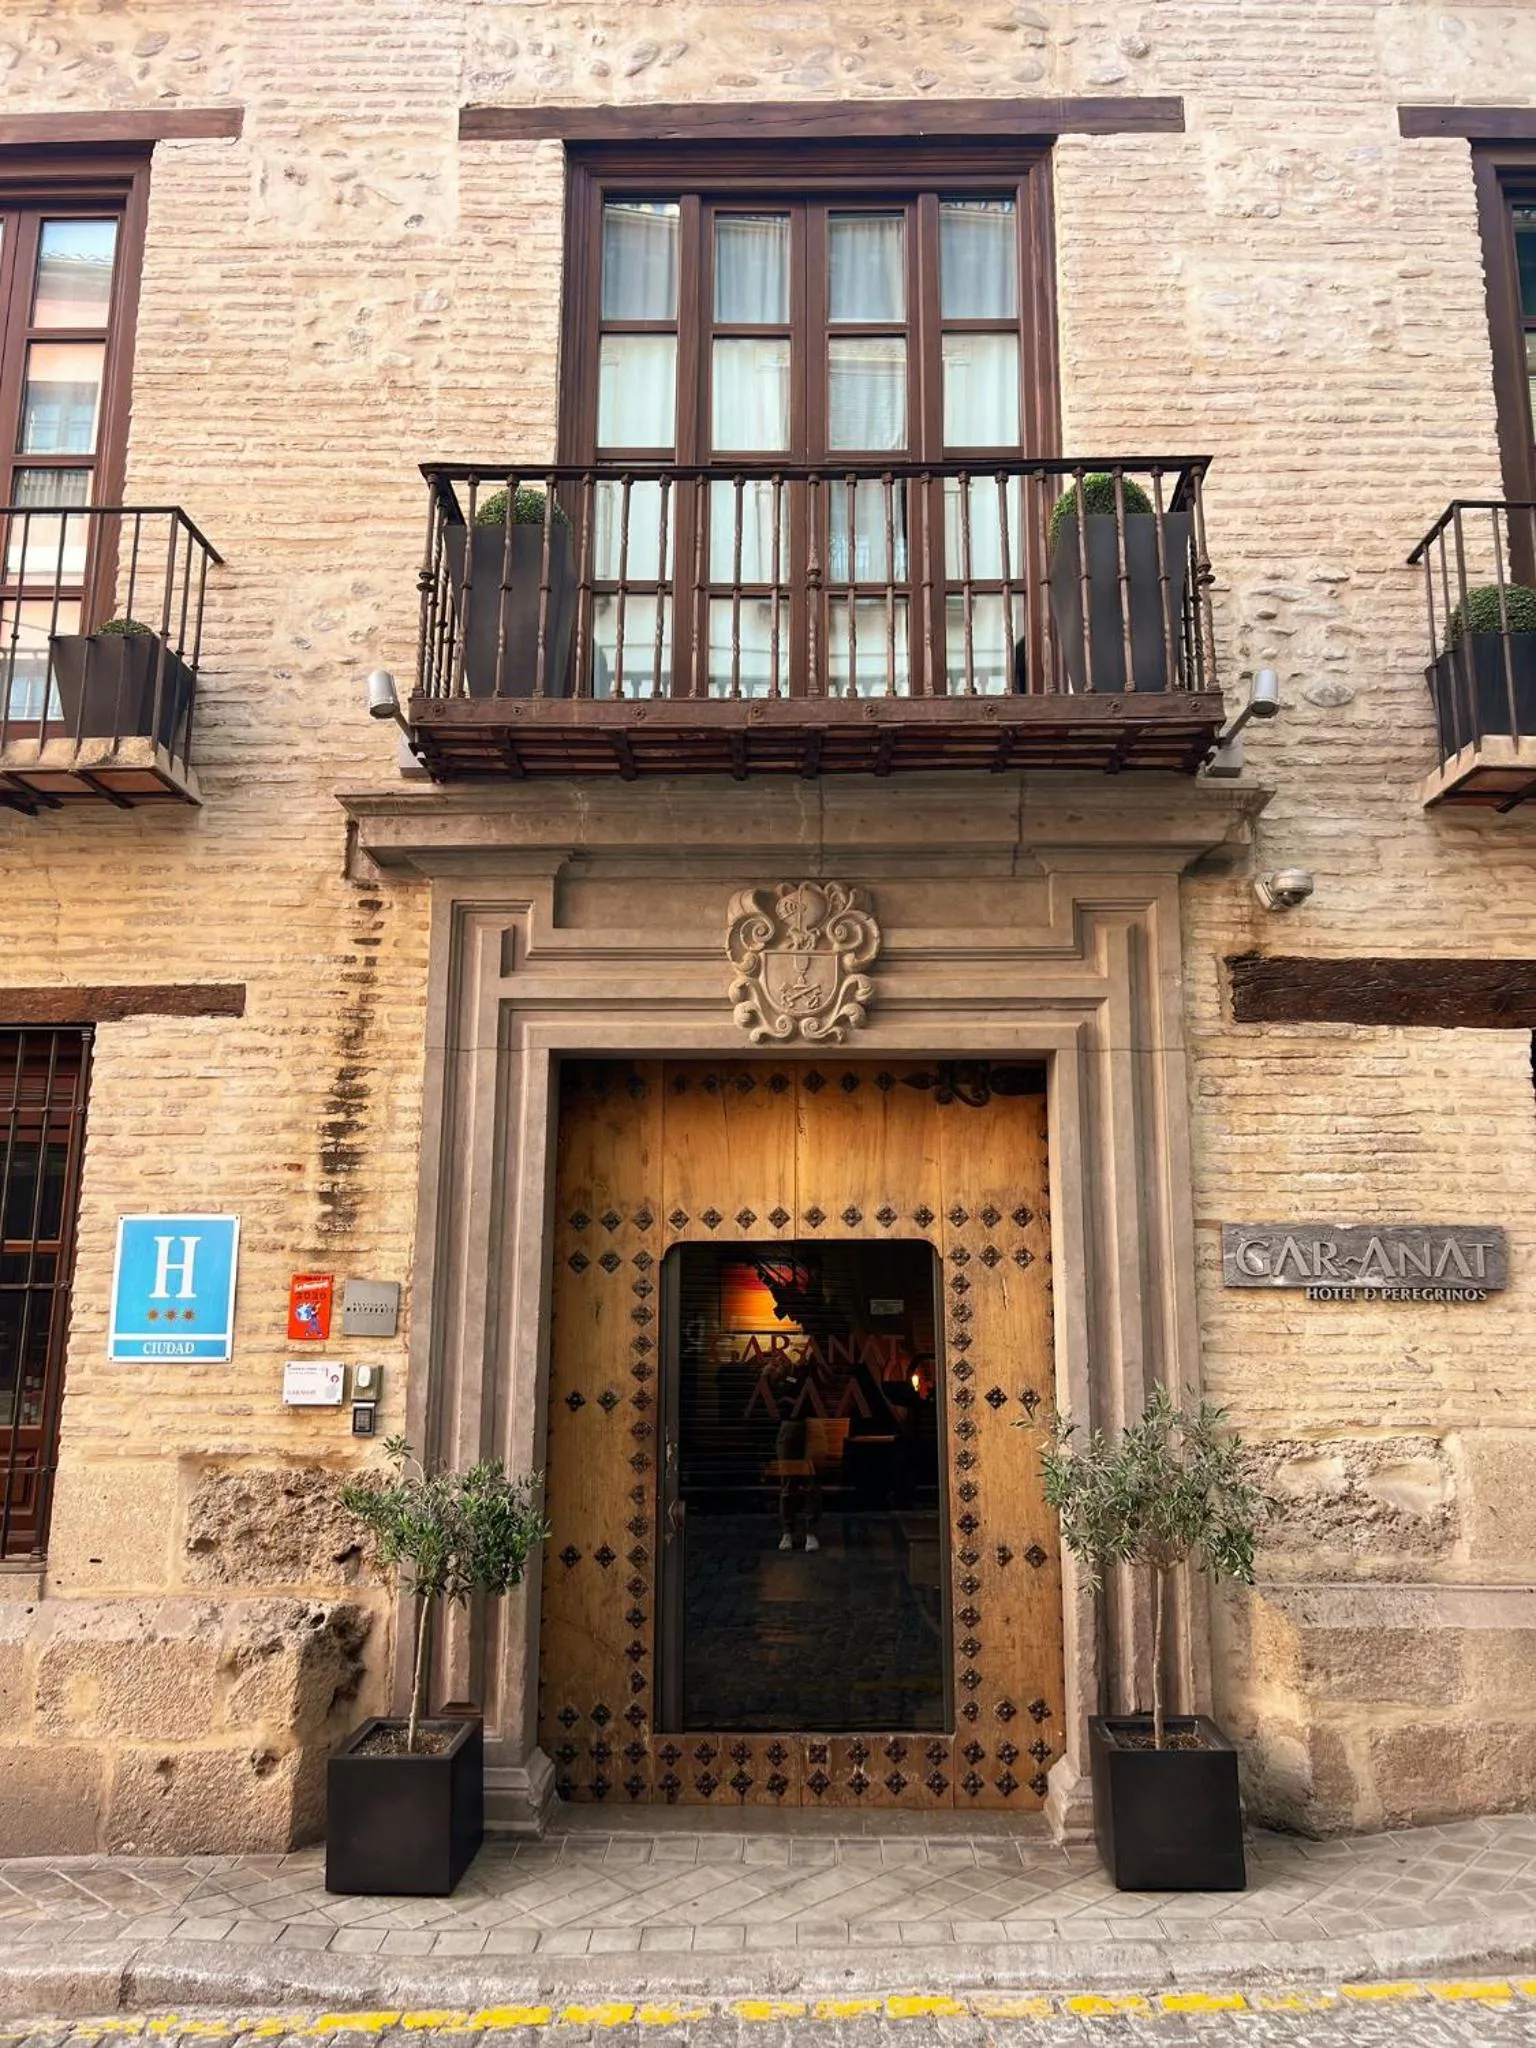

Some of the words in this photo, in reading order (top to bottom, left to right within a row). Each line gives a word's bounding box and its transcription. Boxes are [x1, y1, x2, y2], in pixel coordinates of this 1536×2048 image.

[148, 1235, 202, 1299] H
[1306, 1287, 1358, 1301] HOTEL
[1381, 1288, 1488, 1301] PEREGRINOS
[143, 1341, 195, 1355] CIUDAD
